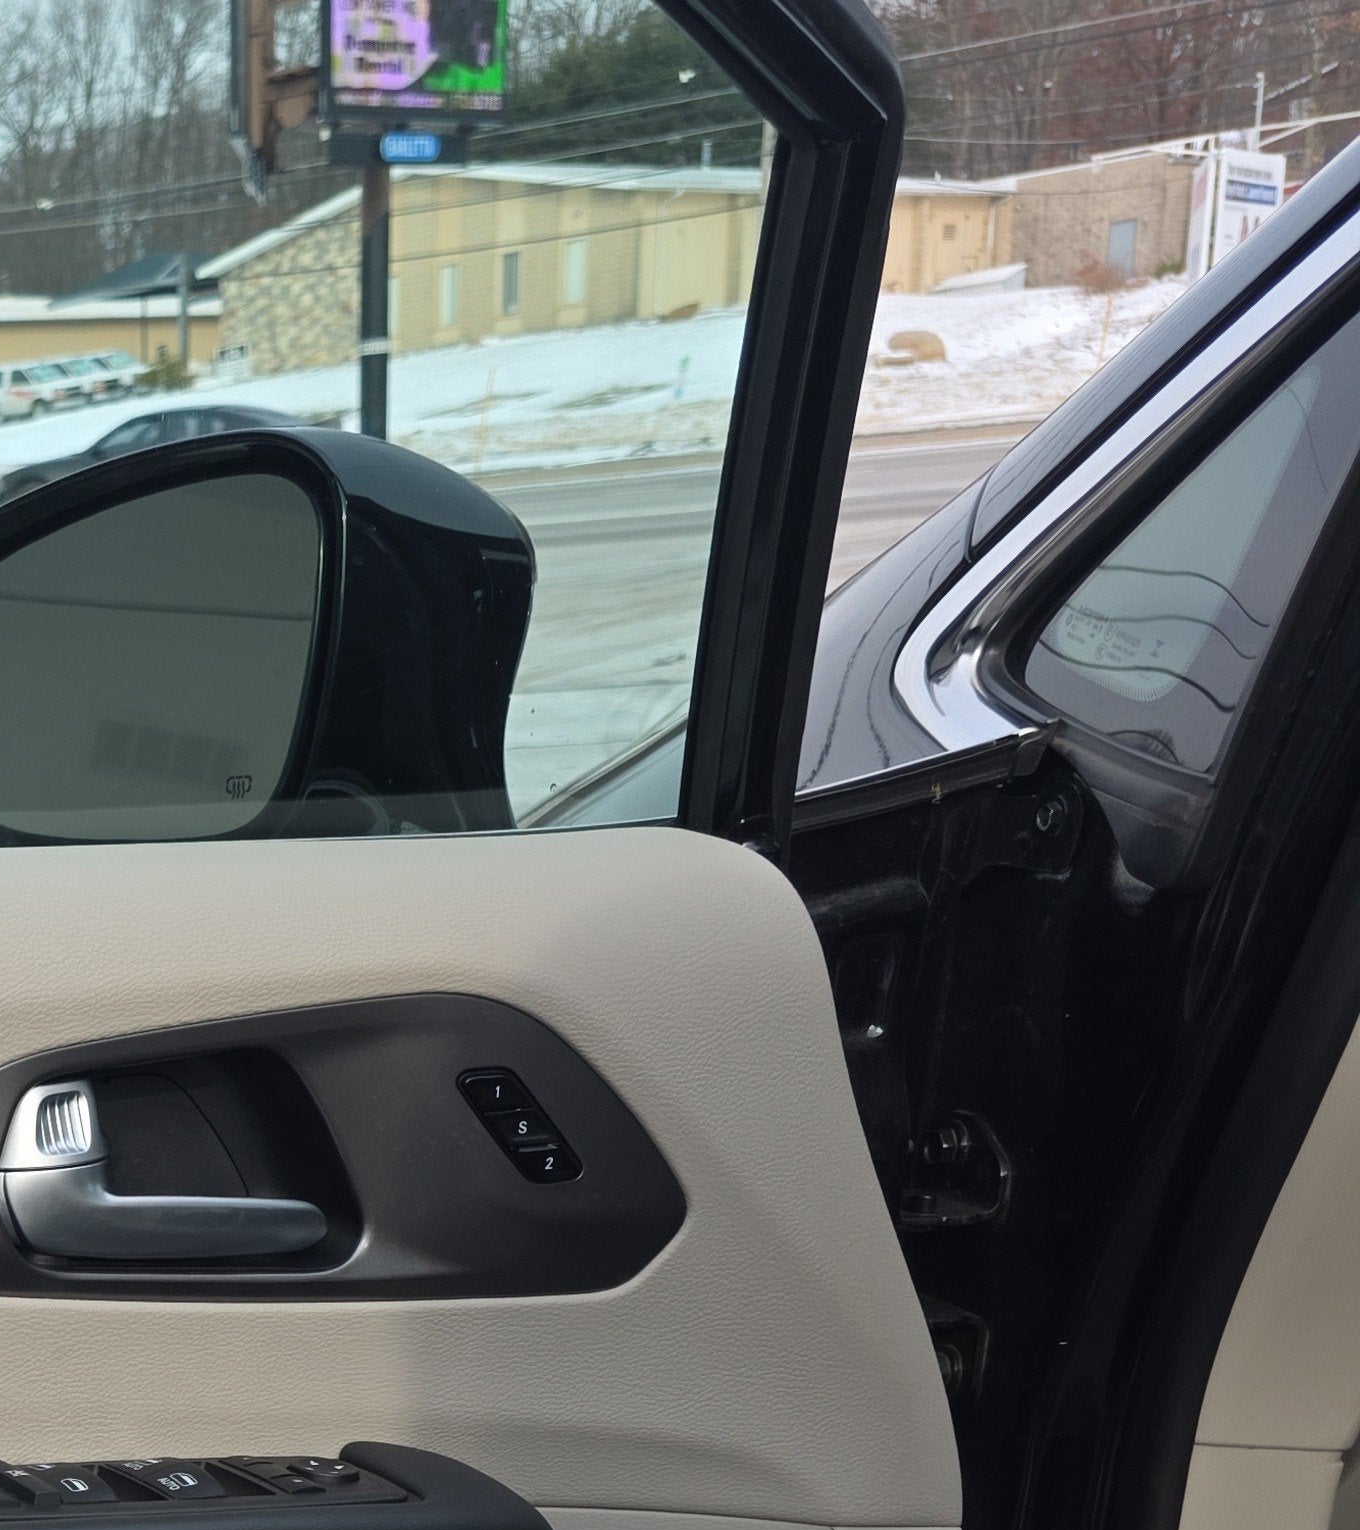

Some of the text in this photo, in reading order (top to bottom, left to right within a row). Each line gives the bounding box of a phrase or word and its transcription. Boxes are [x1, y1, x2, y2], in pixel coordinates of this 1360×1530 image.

[495, 1085, 501, 1098] 1
[517, 1120, 528, 1134] S
[544, 1157, 554, 1170] 2
[157, 1477, 181, 1491] AUTO
